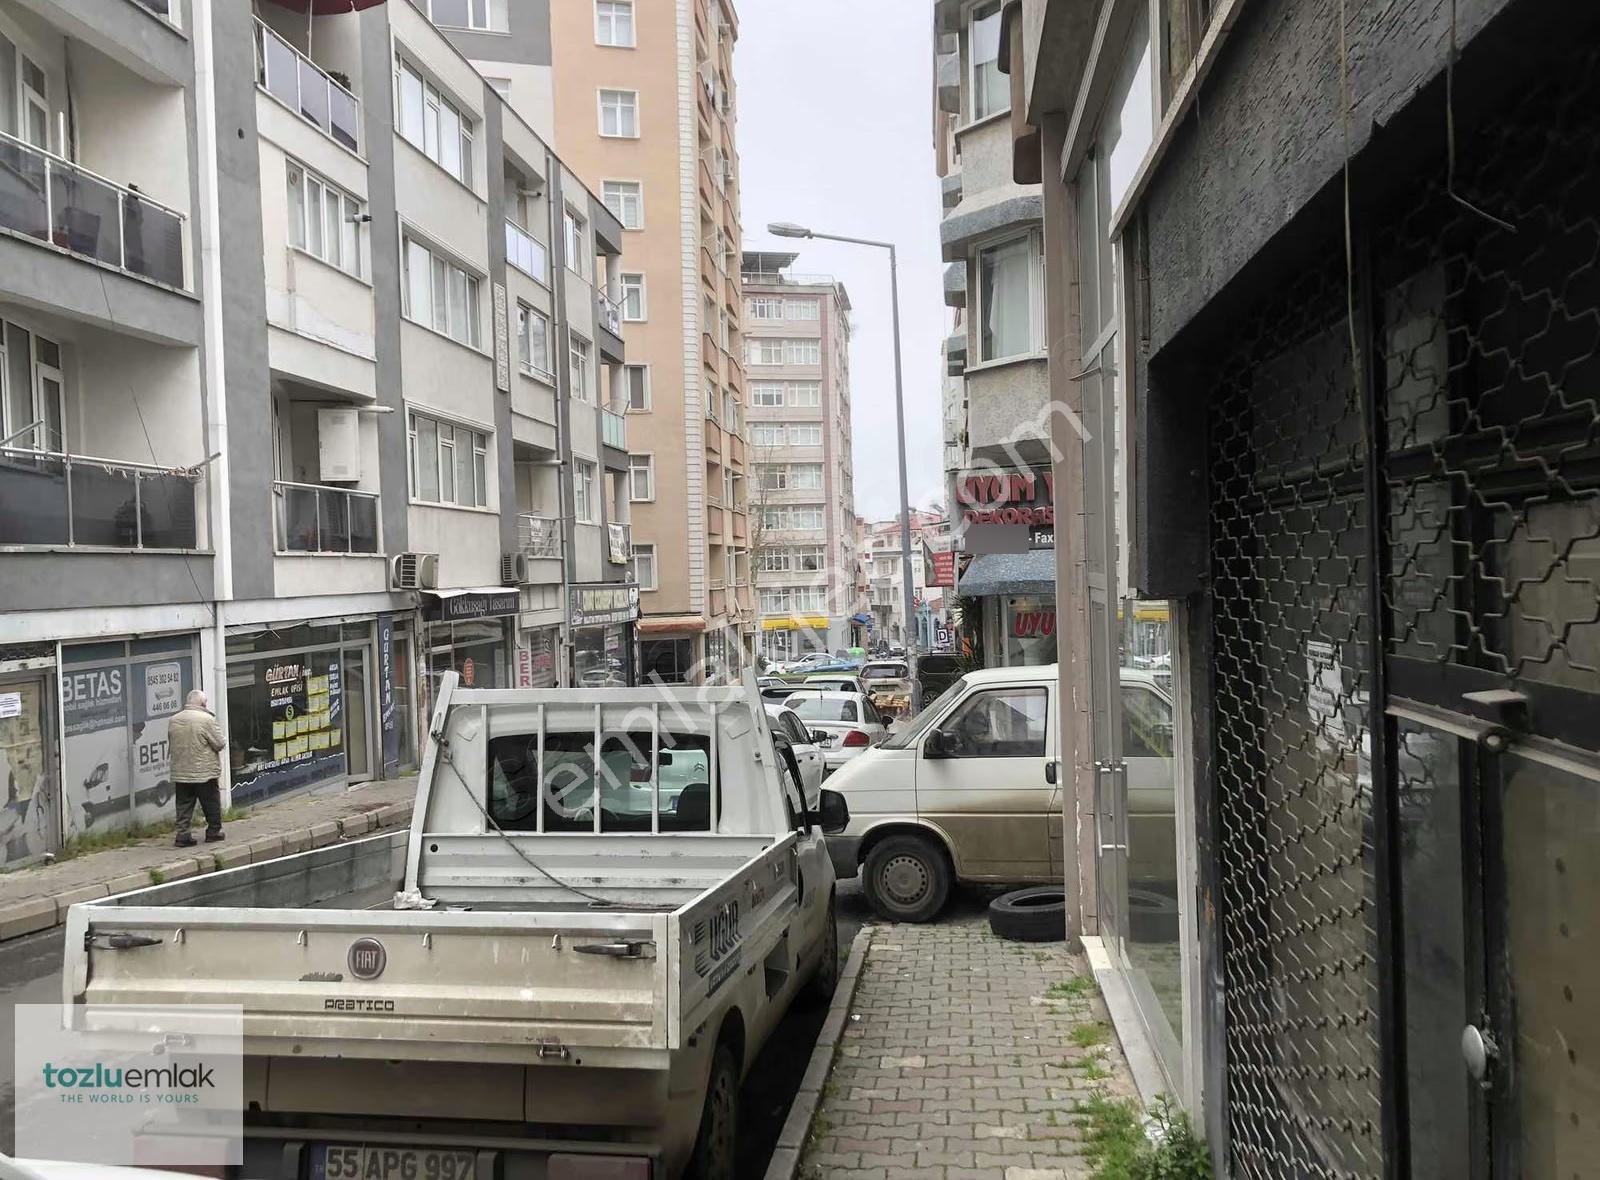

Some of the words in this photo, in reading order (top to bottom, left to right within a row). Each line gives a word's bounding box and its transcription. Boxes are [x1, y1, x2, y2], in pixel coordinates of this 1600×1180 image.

[356, 950, 377, 969] FIAT
[324, 999, 394, 1011] PRATICO
[327, 1150, 358, 1178] 55
[365, 1151, 417, 1180] APG
[424, 1153, 473, 1180] 997
